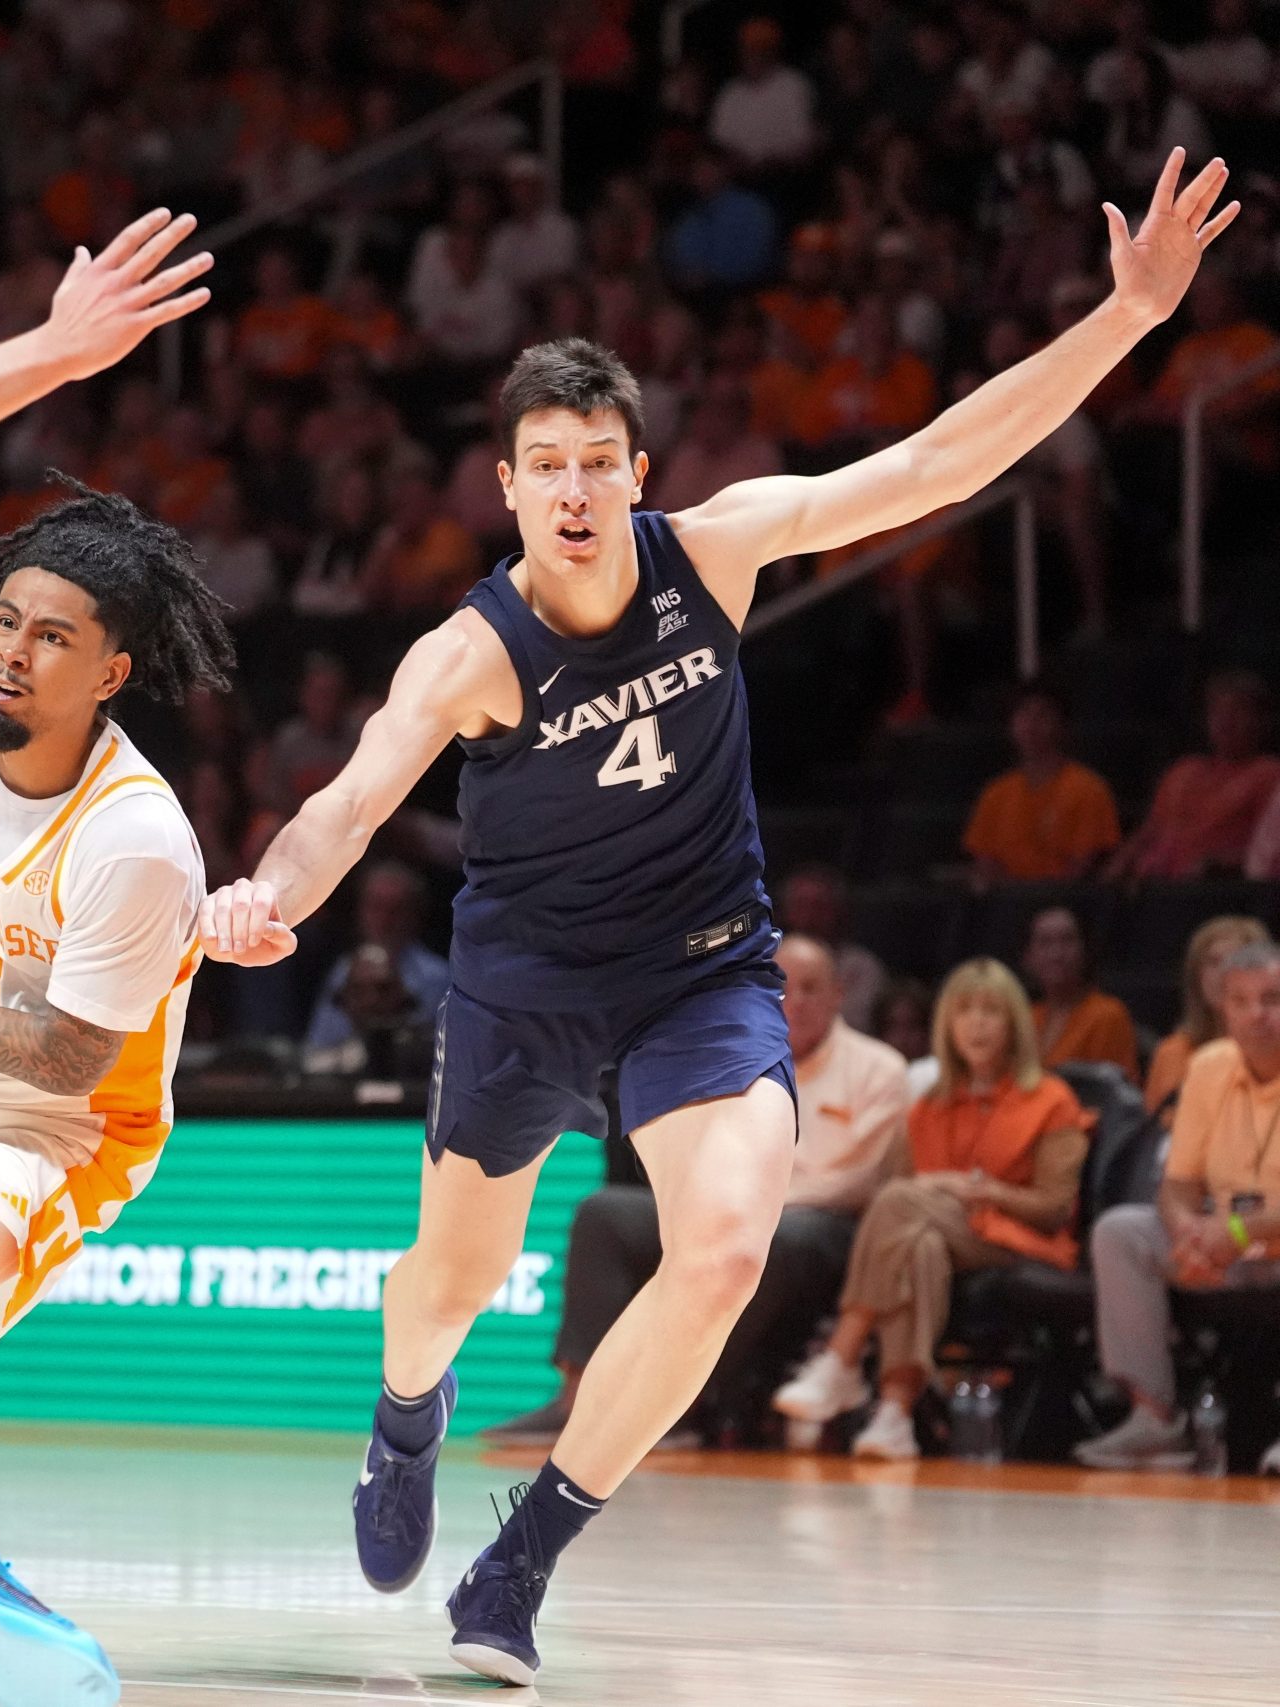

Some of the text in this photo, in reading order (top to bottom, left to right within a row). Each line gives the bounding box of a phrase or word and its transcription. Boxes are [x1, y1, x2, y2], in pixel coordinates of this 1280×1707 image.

[657, 614, 689, 637] EAST
[658, 610, 680, 628] BIG
[532, 646, 724, 750] XAVIER
[597, 714, 677, 792] 4
[26, 872, 49, 895] SEC
[733, 922, 744, 934] 48
